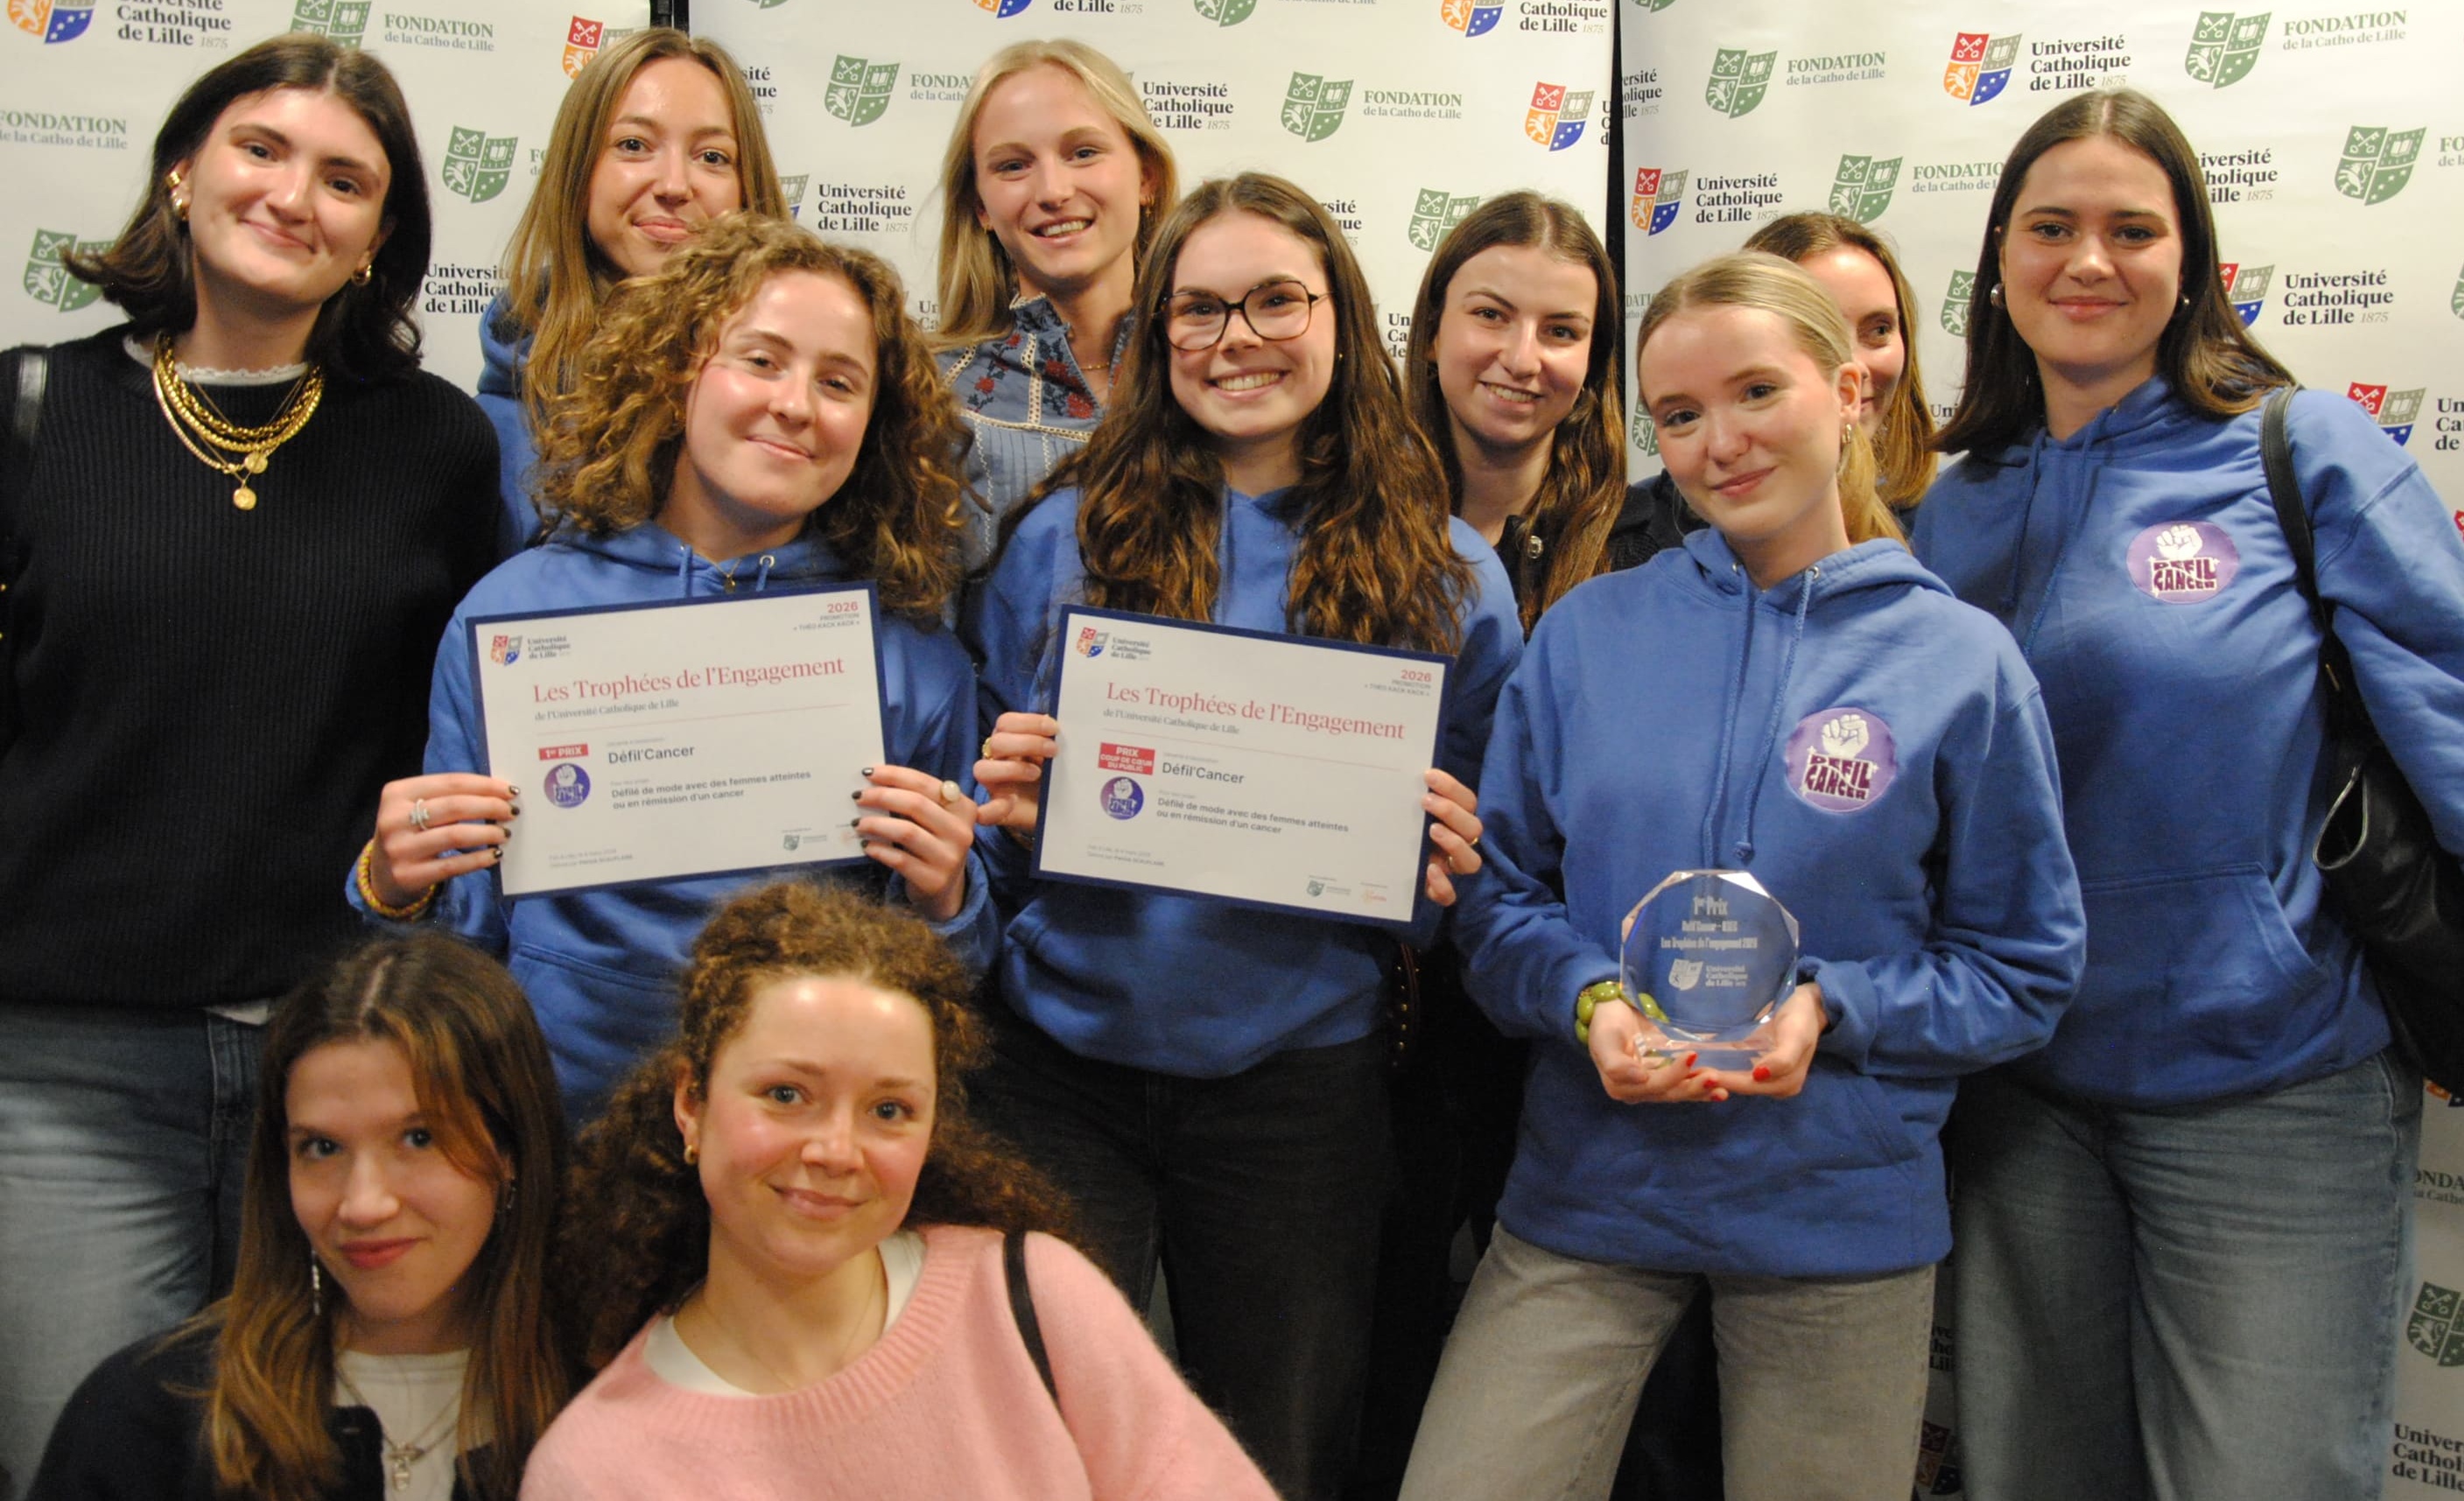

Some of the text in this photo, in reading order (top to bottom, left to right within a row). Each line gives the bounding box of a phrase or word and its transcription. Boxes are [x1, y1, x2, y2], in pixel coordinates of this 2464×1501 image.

[1054, 0, 1142, 14] de Lille 1875
[1520, 2, 1608, 21] Catholique
[116, 4, 232, 32] Catholique
[384, 13, 494, 38] FONDATION
[1520, 17, 1604, 33] de Lille 1875
[2284, 10, 2407, 36] FONDATION
[117, 24, 228, 49] de Lille 1875
[384, 32, 495, 52] de la Catho de Lille
[2032, 34, 2124, 56] Université
[2283, 29, 2405, 50] de la Catho de Lille
[1787, 53, 1885, 73] FONDATION
[2031, 54, 2131, 74] Catholique
[1622, 68, 1657, 87] ersité
[1787, 68, 1885, 86] de la Catho de Lille
[2030, 73, 2126, 91] de Lille 1875
[910, 90, 936, 101] de la
[1143, 81, 1228, 97] Université
[1624, 87, 1662, 103] olique
[1143, 98, 1234, 116] Catholique
[1365, 90, 1463, 107] FONDATION
[1364, 106, 1462, 119] de la Catho de Lille
[1165, 115, 1231, 130] Lille 1875
[14, 130, 128, 150] la Catho de Lille
[2201, 148, 2271, 167] iversité
[2438, 155, 2455, 166] de
[1913, 162, 2004, 179] FONDATIO
[2206, 169, 2278, 186] holique
[1697, 173, 1778, 191] Université
[1913, 183, 1926, 193] de
[1928, 182, 1938, 192] la
[1940, 180, 1974, 191] Catho
[1976, 179, 1990, 189] de
[818, 184, 906, 200] Université
[1696, 191, 1783, 207] Catholique
[2211, 187, 2273, 203] ille 1875
[818, 200, 912, 219] Catholique
[1696, 207, 1779, 223] de Lille 1875
[818, 216, 909, 233] de Lille 1875
[2285, 270, 2387, 289] Université
[425, 298, 446, 312] de
[2284, 290, 2394, 308] Catholique
[2283, 308, 2389, 326] de Lille 1875
[2435, 435, 2460, 450] de
[2153, 569, 2215, 591] CANCER
[827, 601, 859, 614] 2026
[527, 635, 567, 645] Université
[528, 643, 571, 652] Catholique
[1400, 670, 1431, 682] 2026
[533, 684, 570, 703] Les
[573, 673, 671, 700] Trophées
[677, 670, 701, 689] de
[535, 712, 545, 721] de
[599, 701, 647, 714] Catholique
[648, 701, 659, 710] de
[661, 698, 680, 710] Lille
[1106, 682, 1140, 703] Les
[1146, 687, 1237, 716] Trophées
[1241, 700, 1266, 719] de
[1103, 708, 1114, 717] de
[1162, 716, 1208, 731] Catholique
[1209, 723, 1220, 733] de
[1221, 724, 1239, 734] Lille
[558, 746, 582, 758] PRIX
[1116, 747, 1140, 757] PRIX
[612, 771, 811, 798] Défilé de mode avec des femmes atteintes
[1806, 764, 1866, 800] CANCER
[628, 800, 640, 809] en
[642, 794, 688, 807] rémission
[690, 792, 711, 802] d'un
[713, 789, 745, 800] cancer
[1157, 797, 1349, 832] Défilé de mode avec des femmes atteintes
[1183, 812, 1227, 827] rémission
[1229, 819, 1249, 830] d'un
[1251, 823, 1282, 834] cancer
[1706, 895, 1729, 915] Prix
[2394, 1423, 2464, 1453] Univer
[2392, 1461, 2417, 1480] de
